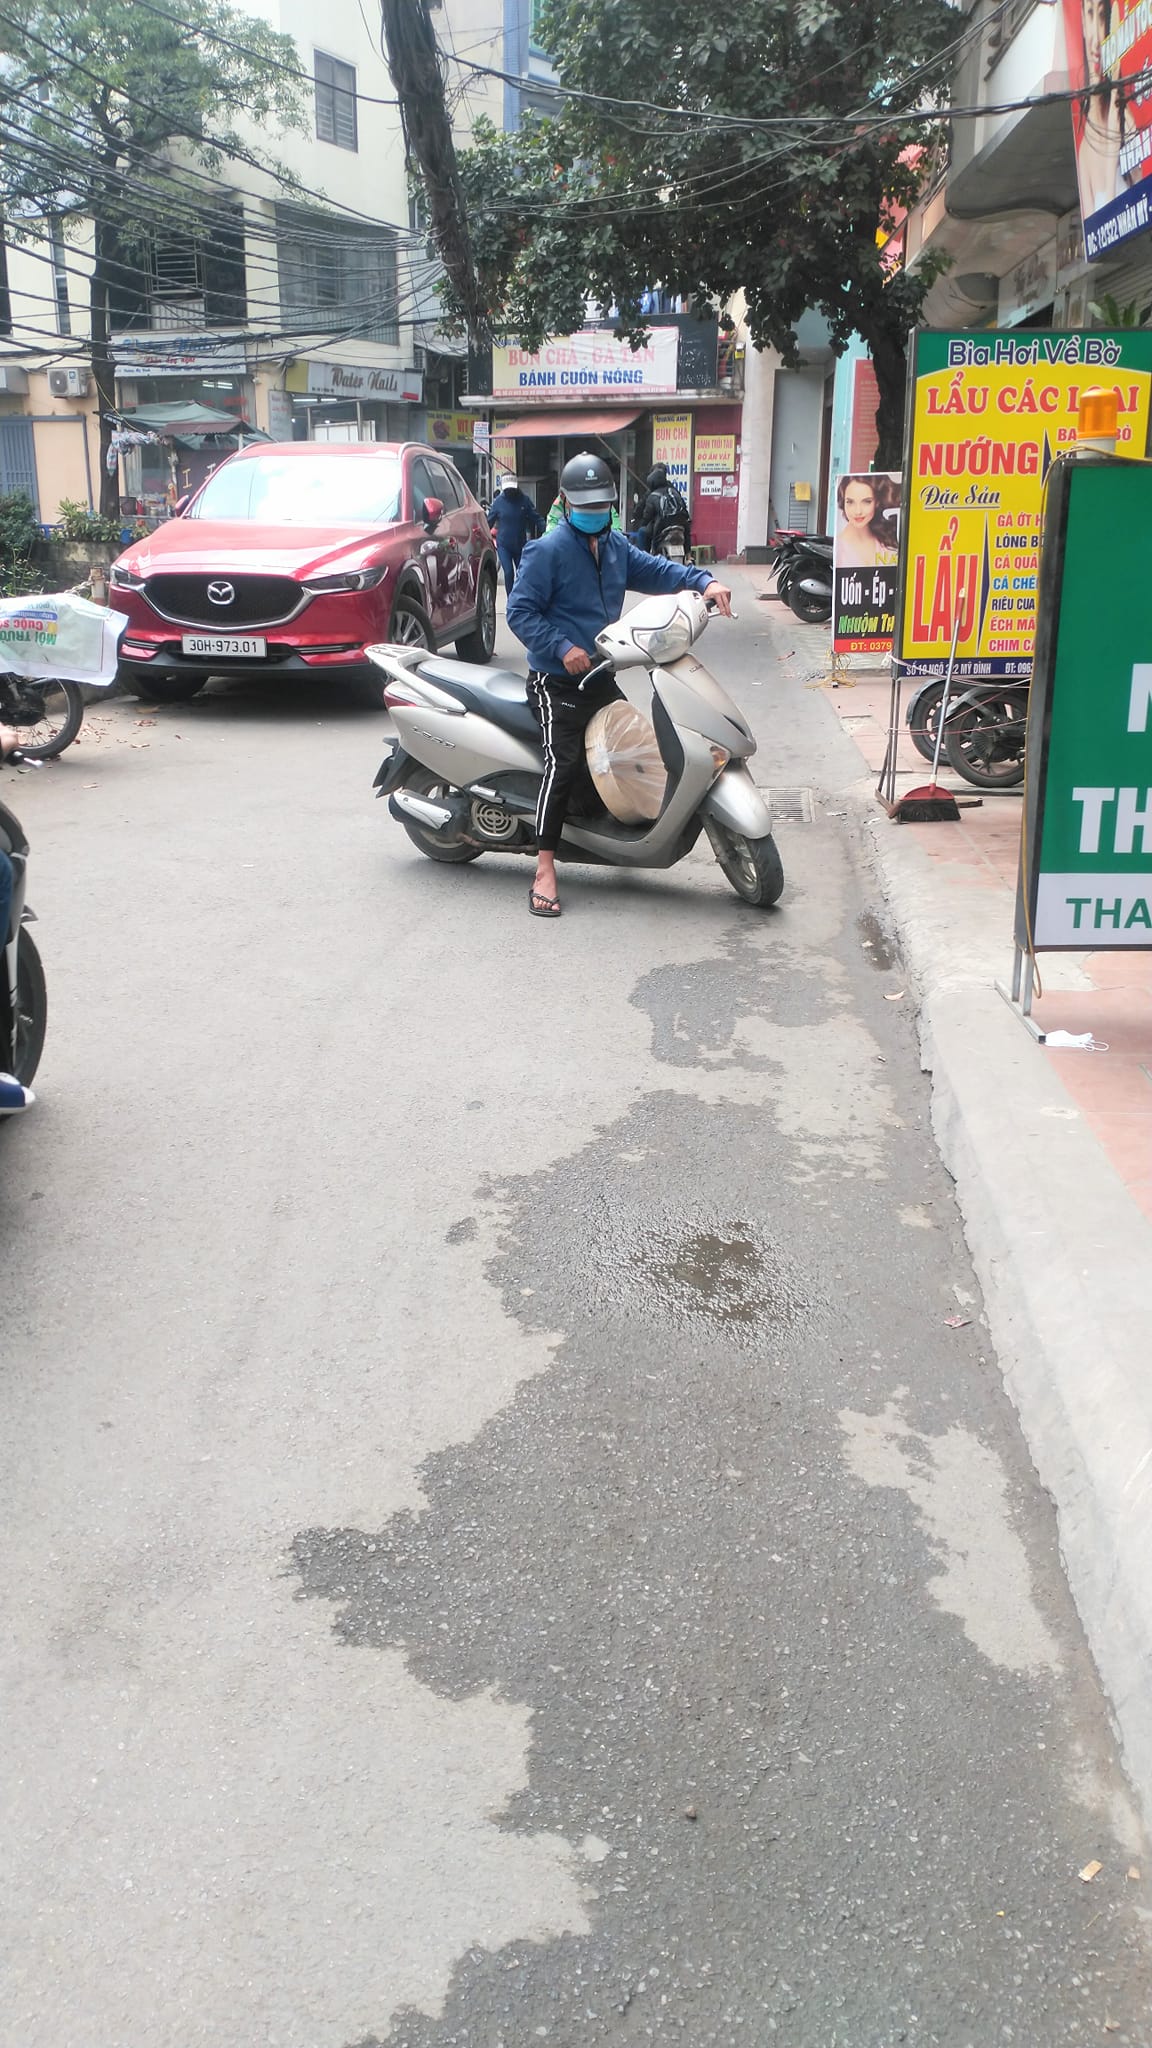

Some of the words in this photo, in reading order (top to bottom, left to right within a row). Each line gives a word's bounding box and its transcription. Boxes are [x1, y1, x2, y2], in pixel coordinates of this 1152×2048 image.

[949, 340, 989, 367] Bia
[995, 339, 1039, 367] Hơi
[1043, 335, 1081, 366] Về
[1084, 338, 1122, 365] Bờ
[367, 371, 398, 392] Nails
[519, 369, 556, 386] BÁNH
[560, 366, 598, 385] CUỐN
[602, 367, 643, 384] NÓNG
[926, 371, 990, 415] LẨU
[997, 379, 1059, 413] CÁC
[918, 436, 1039, 477] NƯỚNG
[919, 485, 959, 508] Đặc
[964, 484, 1001, 504] Sản
[997, 511, 1013, 527] GÀ
[1017, 511, 1032, 527] ỚT
[996, 533, 1027, 548] LÒNG
[994, 554, 1010, 569] CÁ
[1014, 552, 1038, 570] QUẢ
[912, 516, 978, 643] LẨU
[993, 575, 1009, 590] CÁ
[1013, 574, 1038, 590] CHÉ
[841, 572, 862, 605] Uốn
[872, 570, 886, 607] Ép
[992, 596, 1014, 611] RIÊU
[1017, 598, 1035, 610] CUA
[990, 615, 1013, 631] ẾCH
[189, 640, 257, 653] 30H-973.01
[850, 642, 867, 651] ĐT:
[869, 642, 893, 651] 0379
[989, 639, 1020, 652] CHIM
[960, 661, 972, 675] MỸ
[973, 661, 992, 674] ĐÌNH
[1005, 662, 1017, 674] ĐT:
